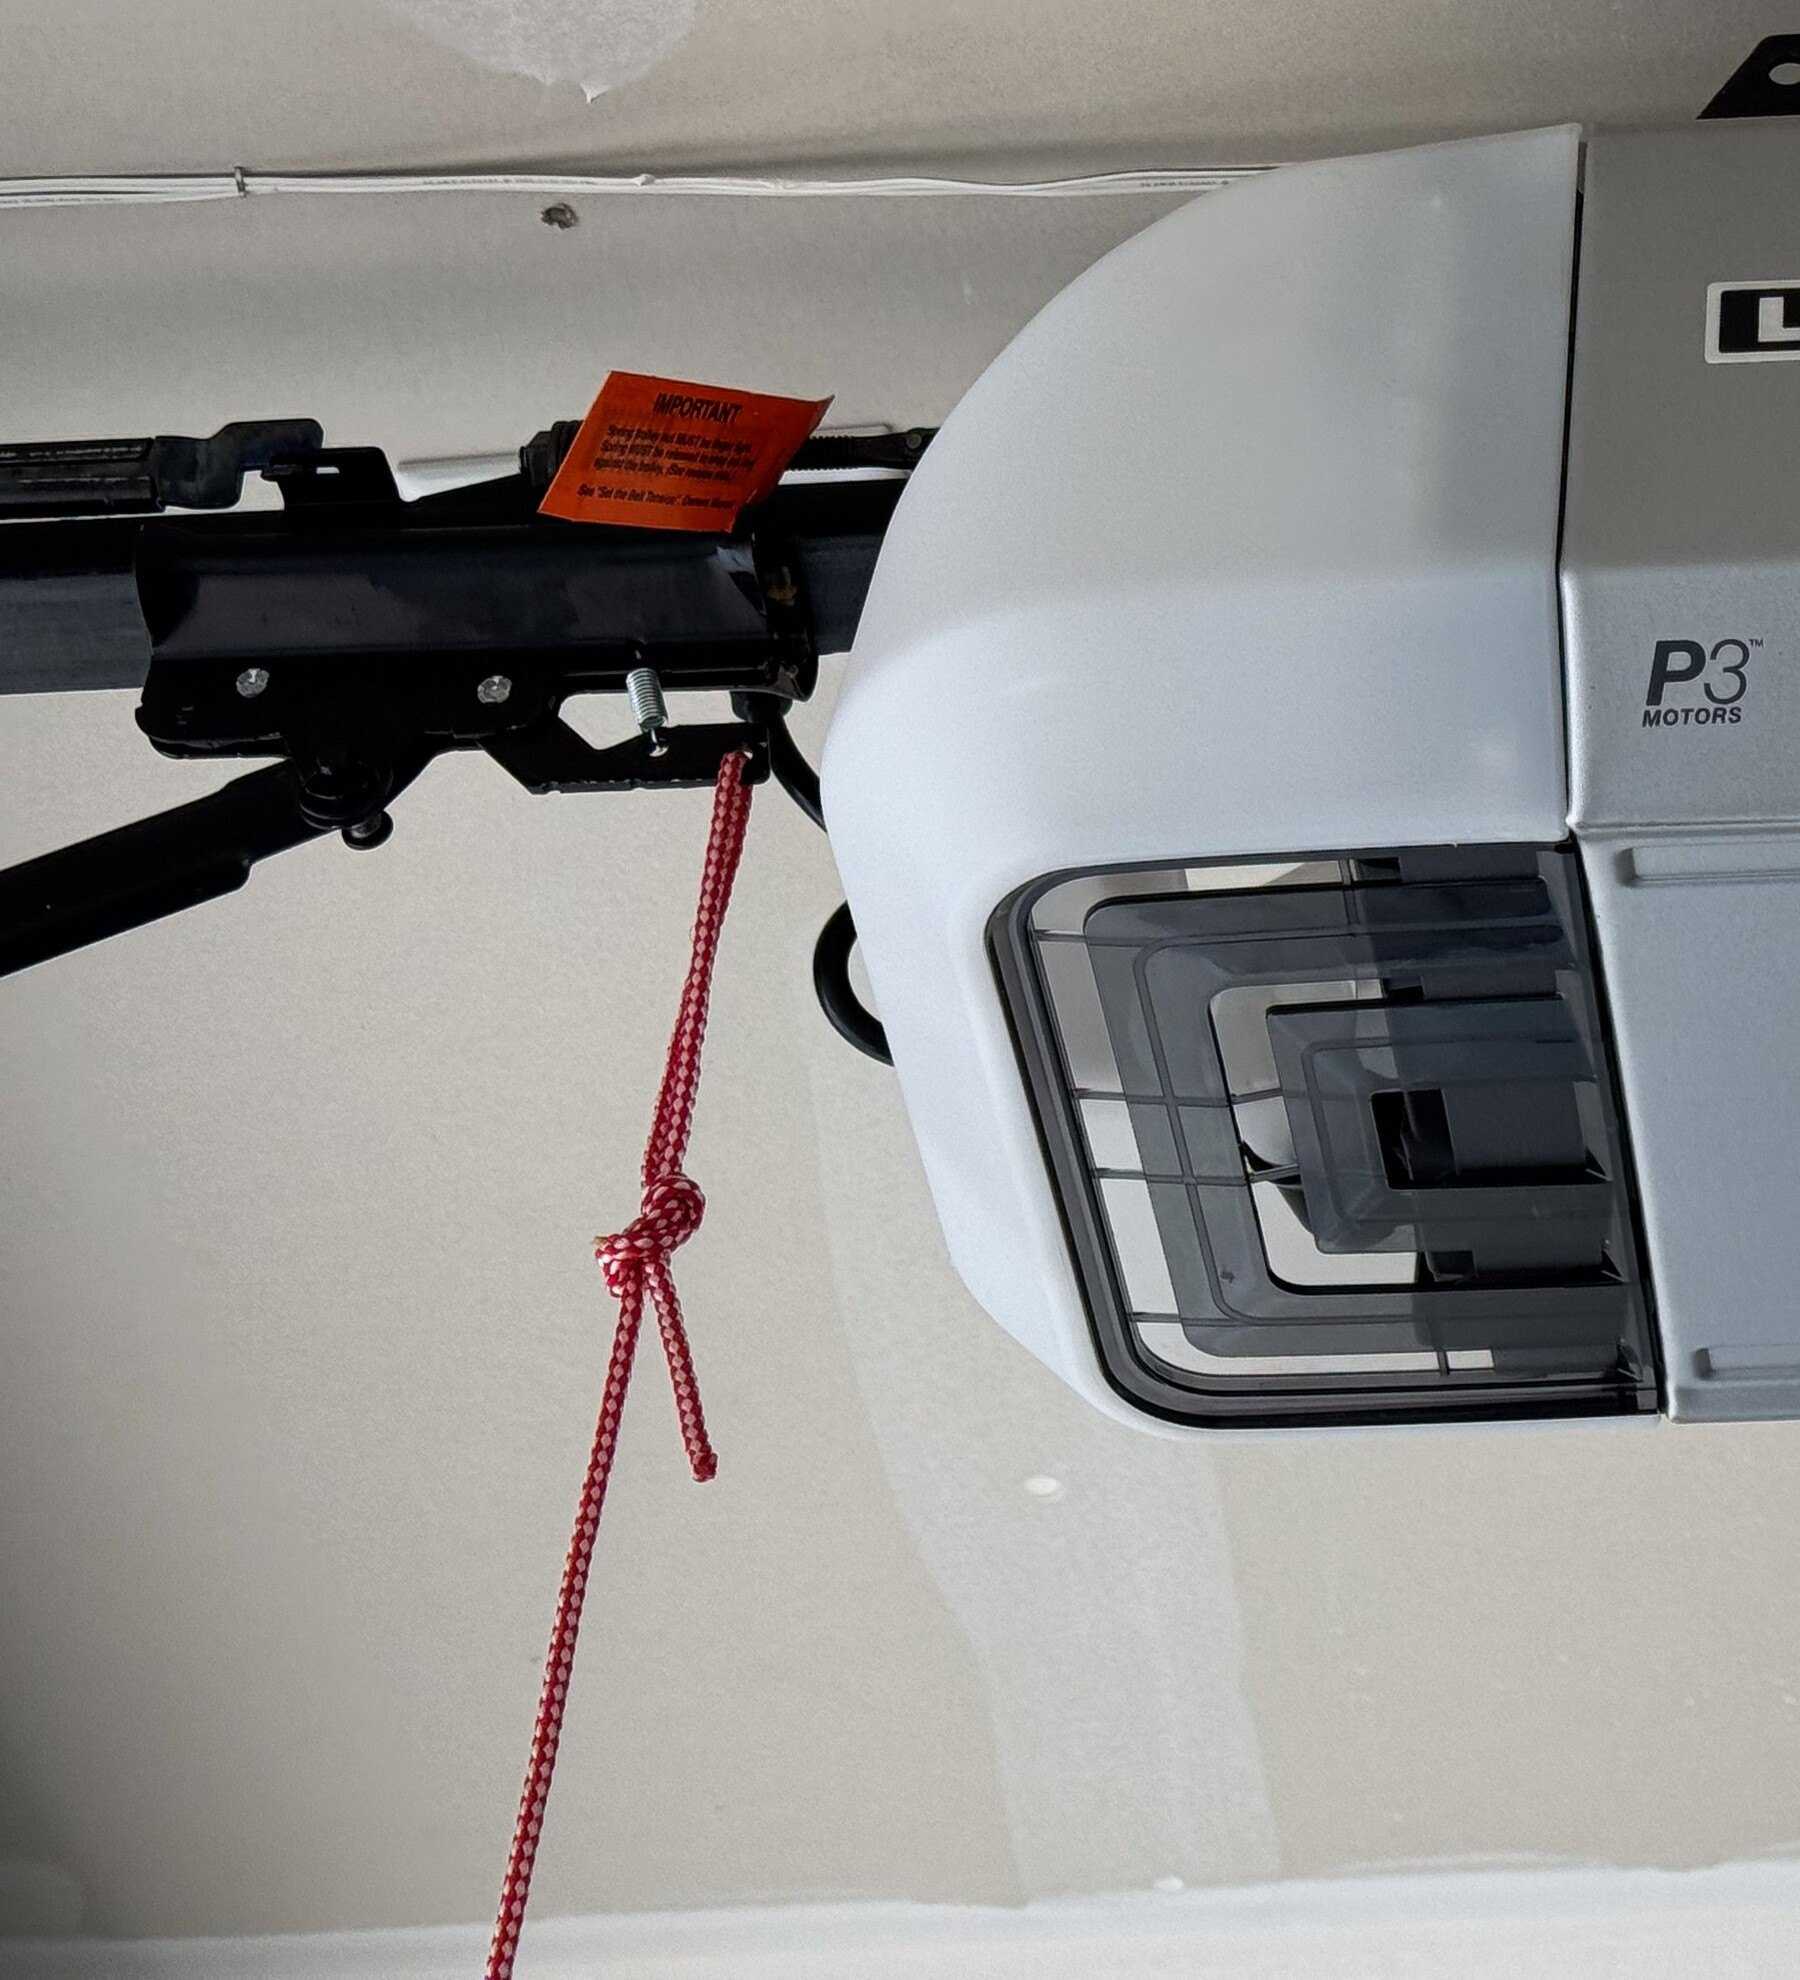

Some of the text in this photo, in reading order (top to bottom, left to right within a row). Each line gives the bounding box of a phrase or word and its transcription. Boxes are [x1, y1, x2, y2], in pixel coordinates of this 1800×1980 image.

[654, 393, 742, 423] IMPORTANT
[578, 483, 595, 495] See
[1642, 706, 1742, 728] MOTORS
